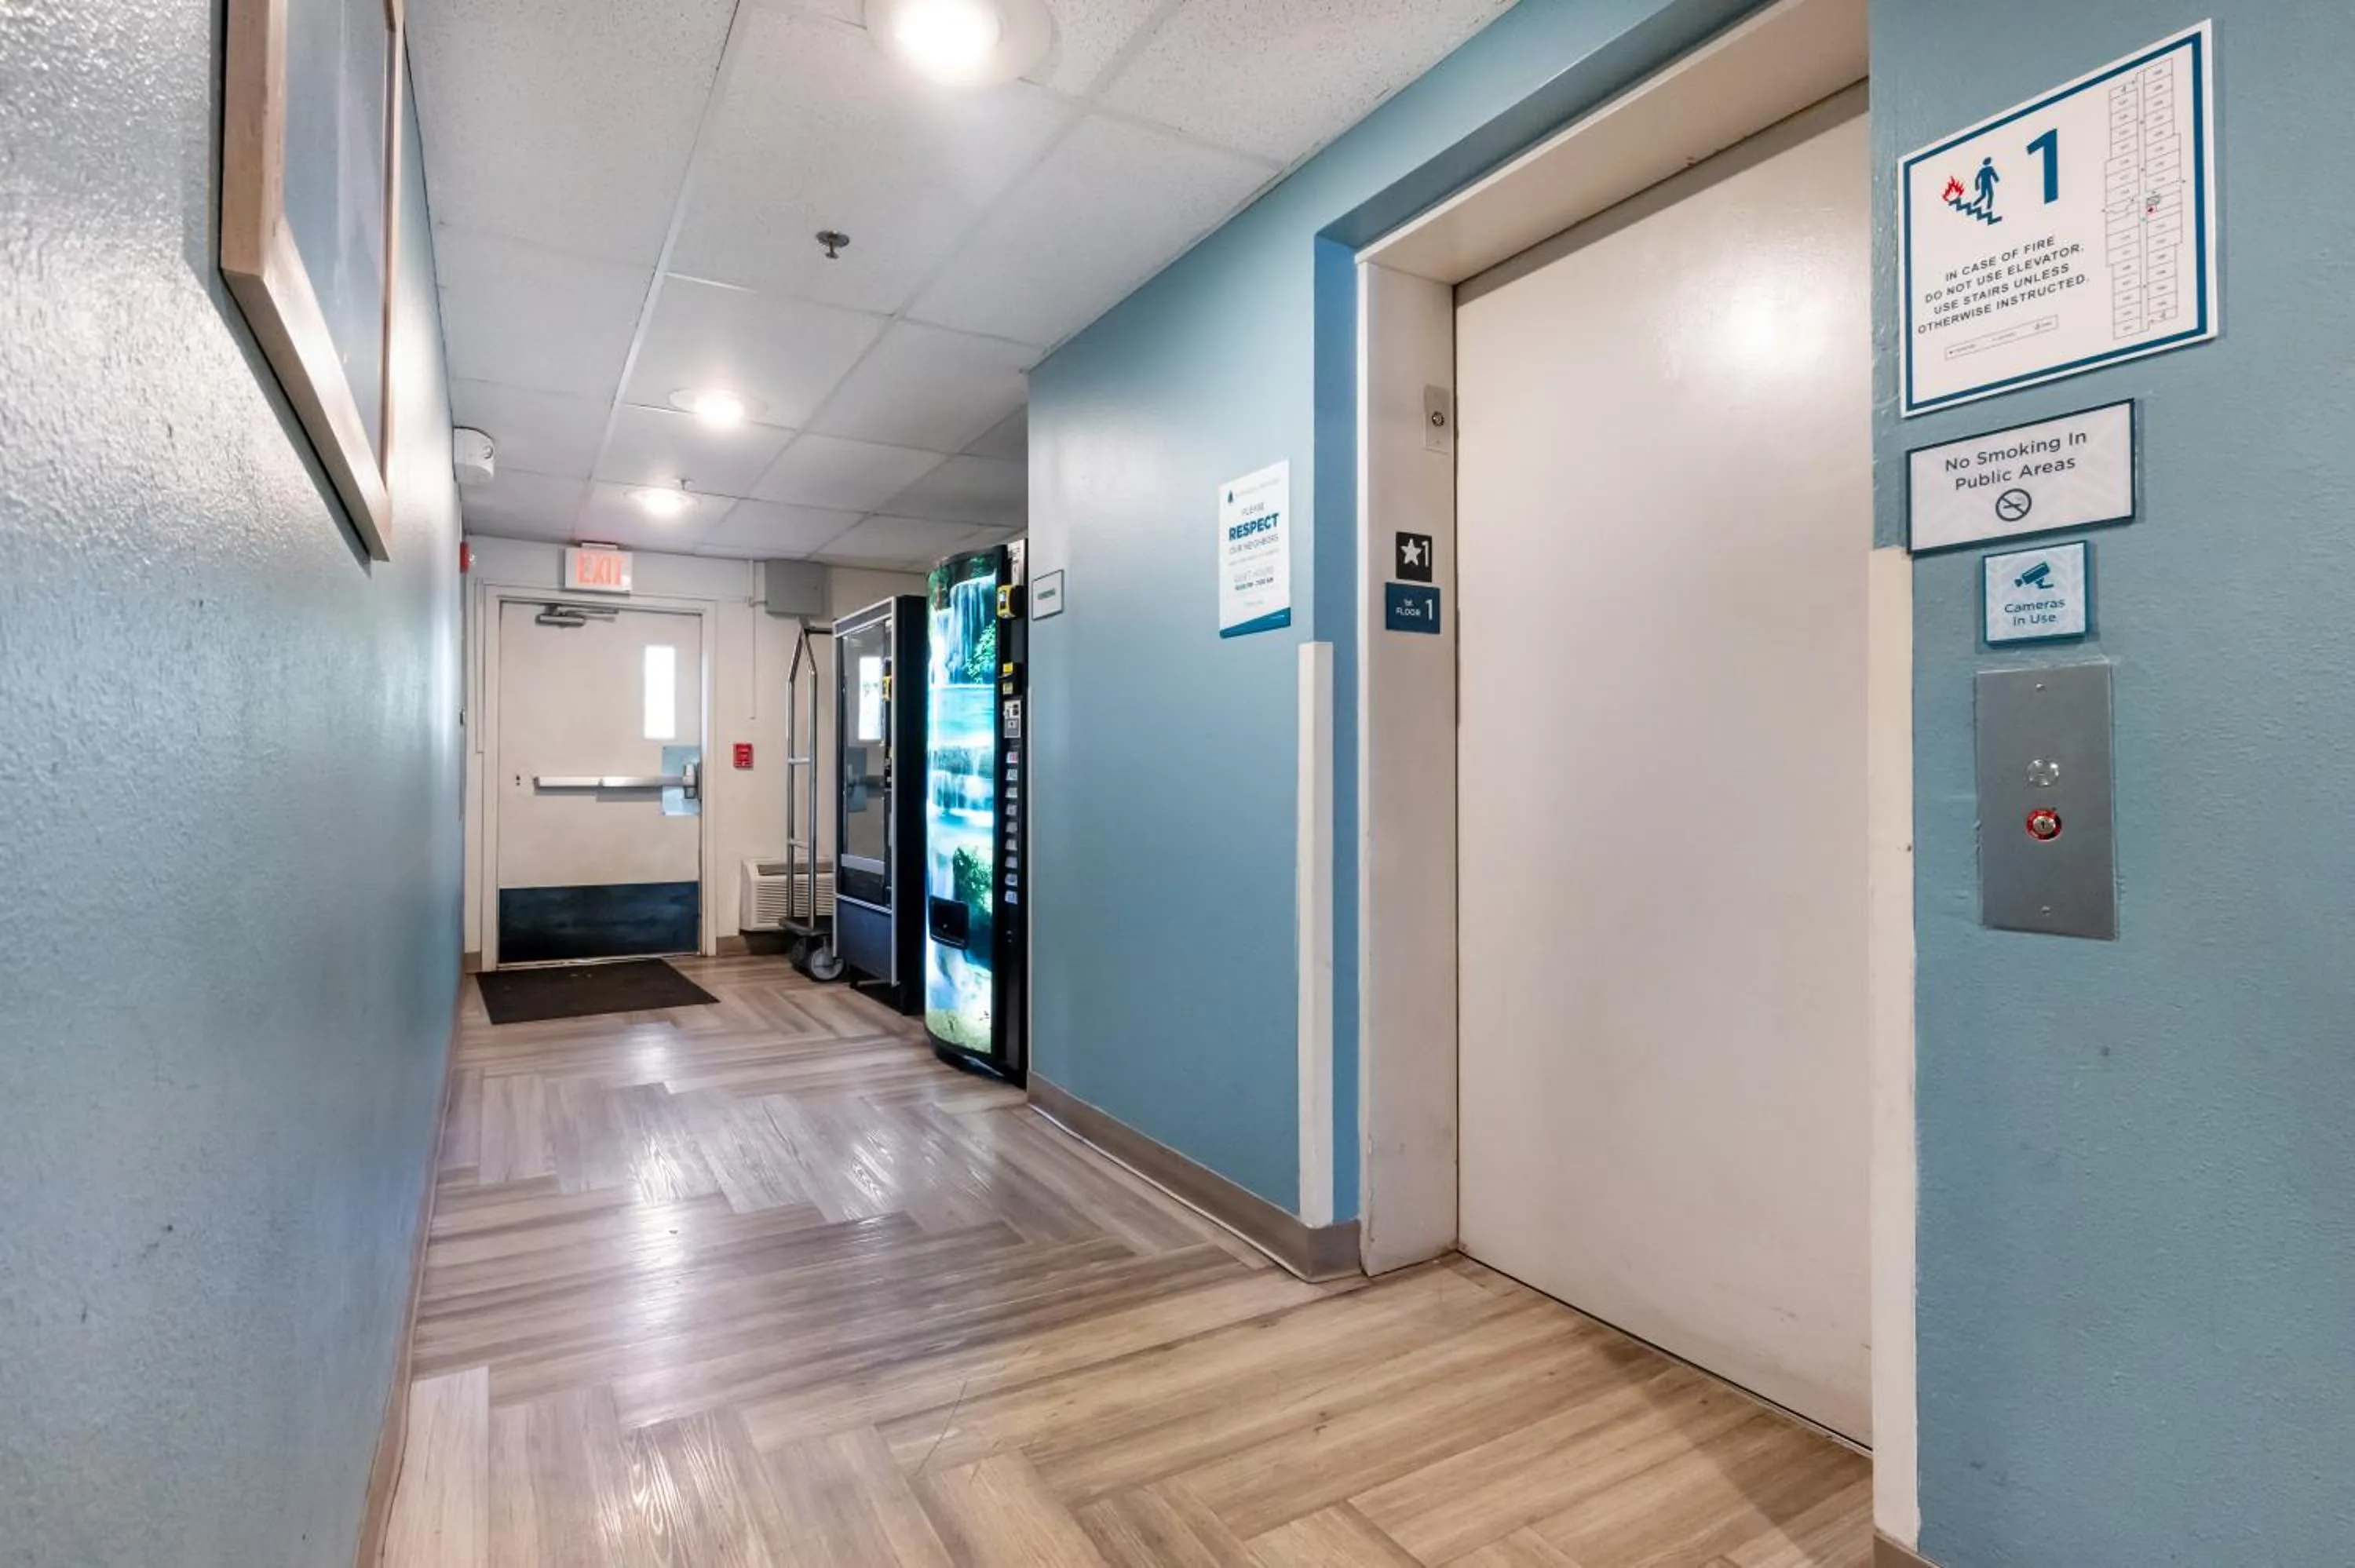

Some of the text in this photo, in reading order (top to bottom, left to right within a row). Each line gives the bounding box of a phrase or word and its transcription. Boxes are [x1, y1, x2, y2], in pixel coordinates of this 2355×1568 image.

[2026, 127, 2059, 205] 1
[1924, 242, 2085, 304] DO NOT USE ELEVATOR.
[1944, 235, 2056, 283] IN CASE OF FIRE
[1917, 273, 2090, 335] OTHERWISE INSTRUCTED.
[1933, 262, 2070, 315] USE STAIRS UNLESS
[1944, 432, 2087, 472] No Smoking In
[1955, 456, 2076, 490] Public Areas
[1229, 512, 1280, 541] RESPECT
[577, 552, 623, 584] EXIT
[1422, 539, 1429, 567] 1
[1425, 599, 1433, 621] 1
[2003, 598, 2067, 614] Cameras
[2029, 612, 2057, 625] Use
